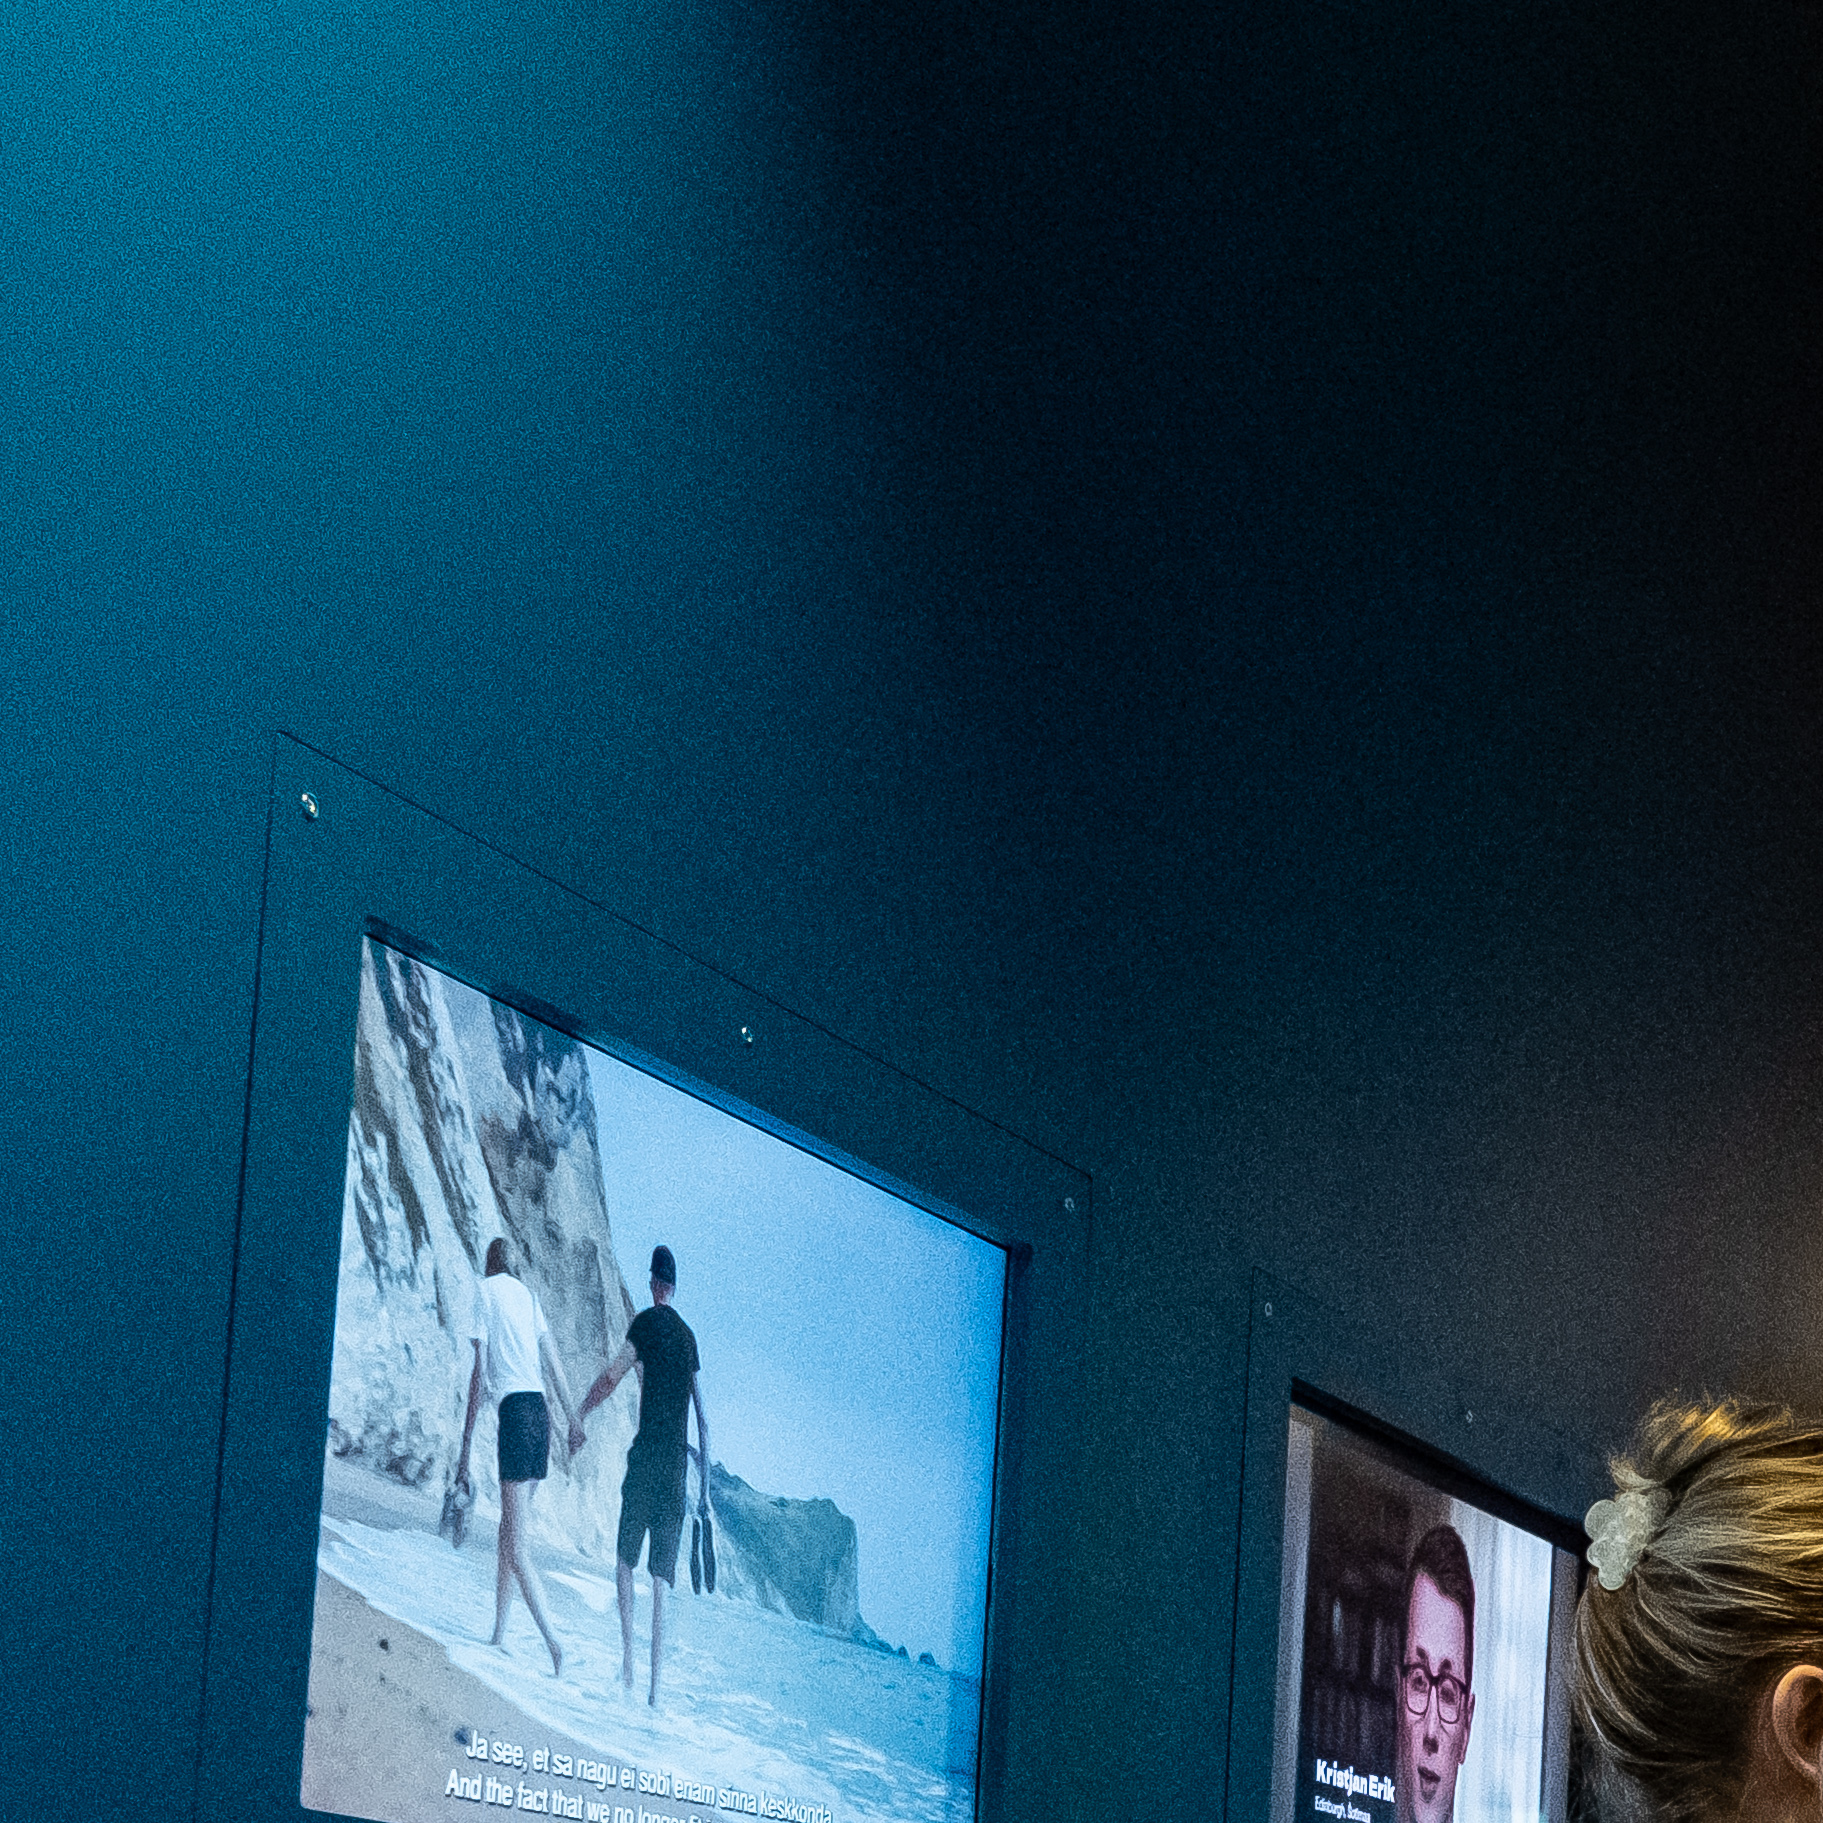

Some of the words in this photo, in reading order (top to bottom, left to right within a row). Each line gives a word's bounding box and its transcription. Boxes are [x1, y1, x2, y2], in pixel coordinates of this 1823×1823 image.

[445, 1768, 482, 1801] And
[486, 1776, 513, 1806] the
[517, 1781, 549, 1813] fact
[552, 1789, 582, 1820] that
[466, 1730, 488, 1760] Ja
[491, 1741, 528, 1773] see,
[532, 1747, 549, 1773] et
[552, 1753, 573, 1777] sa
[577, 1758, 616, 1790] nagu
[620, 1764, 636, 1789] ei
[638, 1768, 670, 1797] sobi
[674, 1778, 715, 1805] enam
[719, 1785, 757, 1814] sinna
[1316, 1758, 1368, 1796] Kristjan
[1368, 1774, 1396, 1804] Erik
